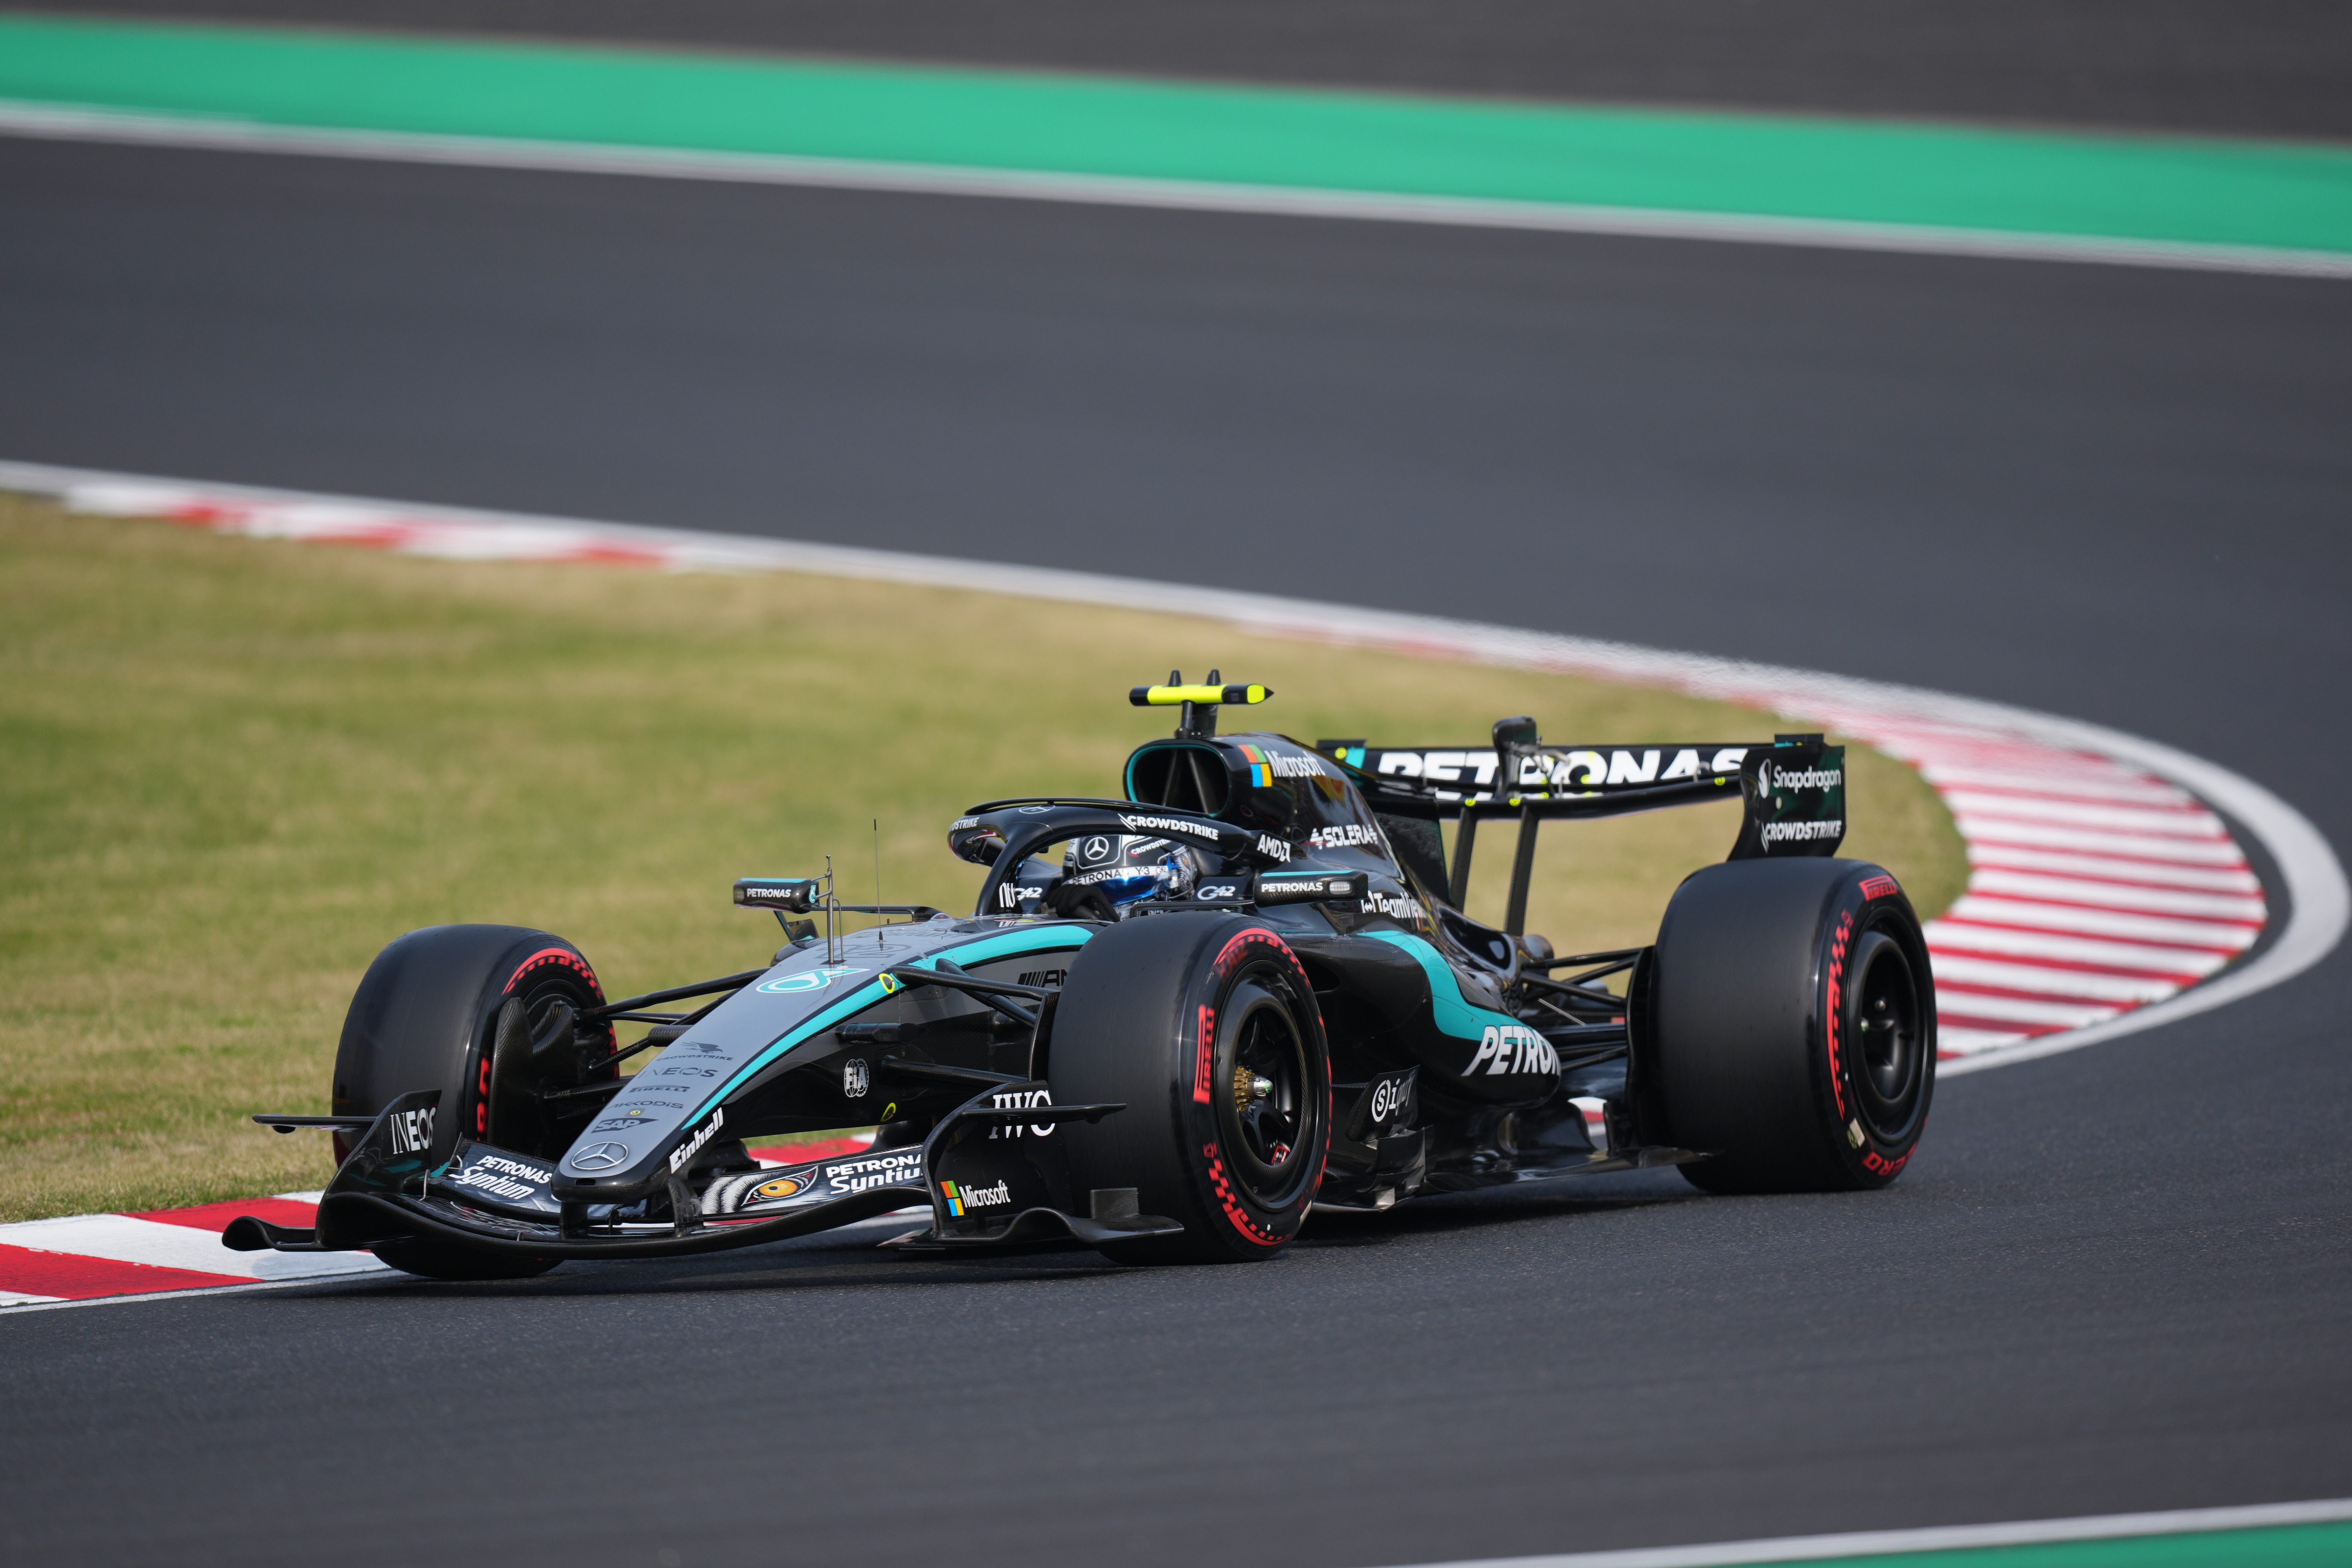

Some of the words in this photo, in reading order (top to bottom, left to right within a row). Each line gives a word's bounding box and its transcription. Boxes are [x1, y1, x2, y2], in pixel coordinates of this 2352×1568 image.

[1265, 751, 1325, 777] Microsoft
[1774, 765, 1841, 793] Snapdragon
[1128, 815, 1219, 840] CROWDSTRIKE
[1322, 825, 1370, 848] SOLERA
[1766, 820, 1842, 841] CROWDSTRIKE
[1072, 868, 1128, 886] PETRONA
[1261, 882, 1323, 892] PETRONAS
[746, 888, 792, 898] PETRONAS
[1197, 885, 1236, 901] G42
[638, 1067, 719, 1079] INEOS
[628, 1085, 691, 1093] PIRELLI
[596, 1119, 641, 1131] SAP
[989, 1090, 1056, 1139] IWC
[390, 1107, 436, 1154] INEOS
[669, 1107, 723, 1174] Einhell
[477, 1156, 553, 1184] PETRONAS
[830, 1167, 924, 1194] Syntiu
[449, 1166, 535, 1200] Syntium
[959, 1179, 1011, 1208] Microsoft
